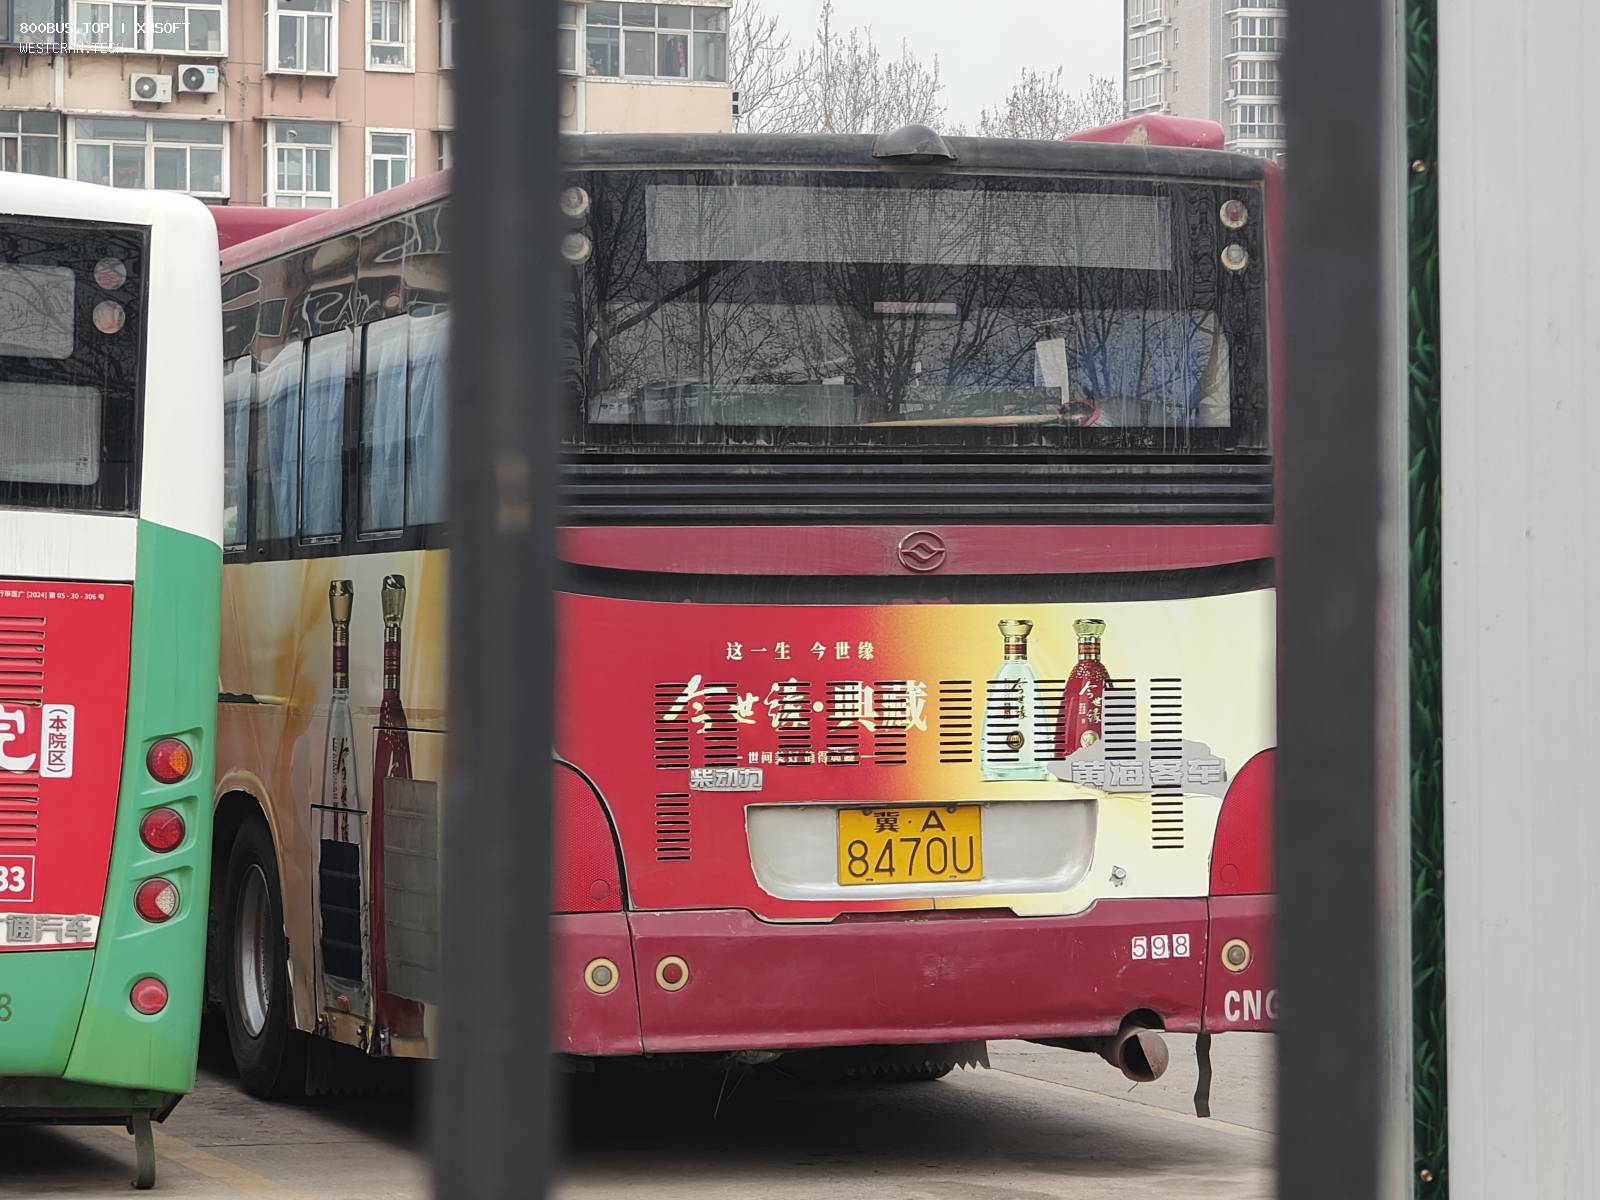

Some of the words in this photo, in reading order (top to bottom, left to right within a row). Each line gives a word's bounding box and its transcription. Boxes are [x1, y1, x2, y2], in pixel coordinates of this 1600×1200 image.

[726, 641, 791, 660] 这一生
[810, 641, 875, 660] 今世缘
[689, 769, 763, 789] 柴动力
[1071, 760, 1222, 786] 黄海客车
[848, 836, 974, 877] 8470U
[0, 914, 92, 944] 通汽车
[1132, 935, 1188, 958] 598
